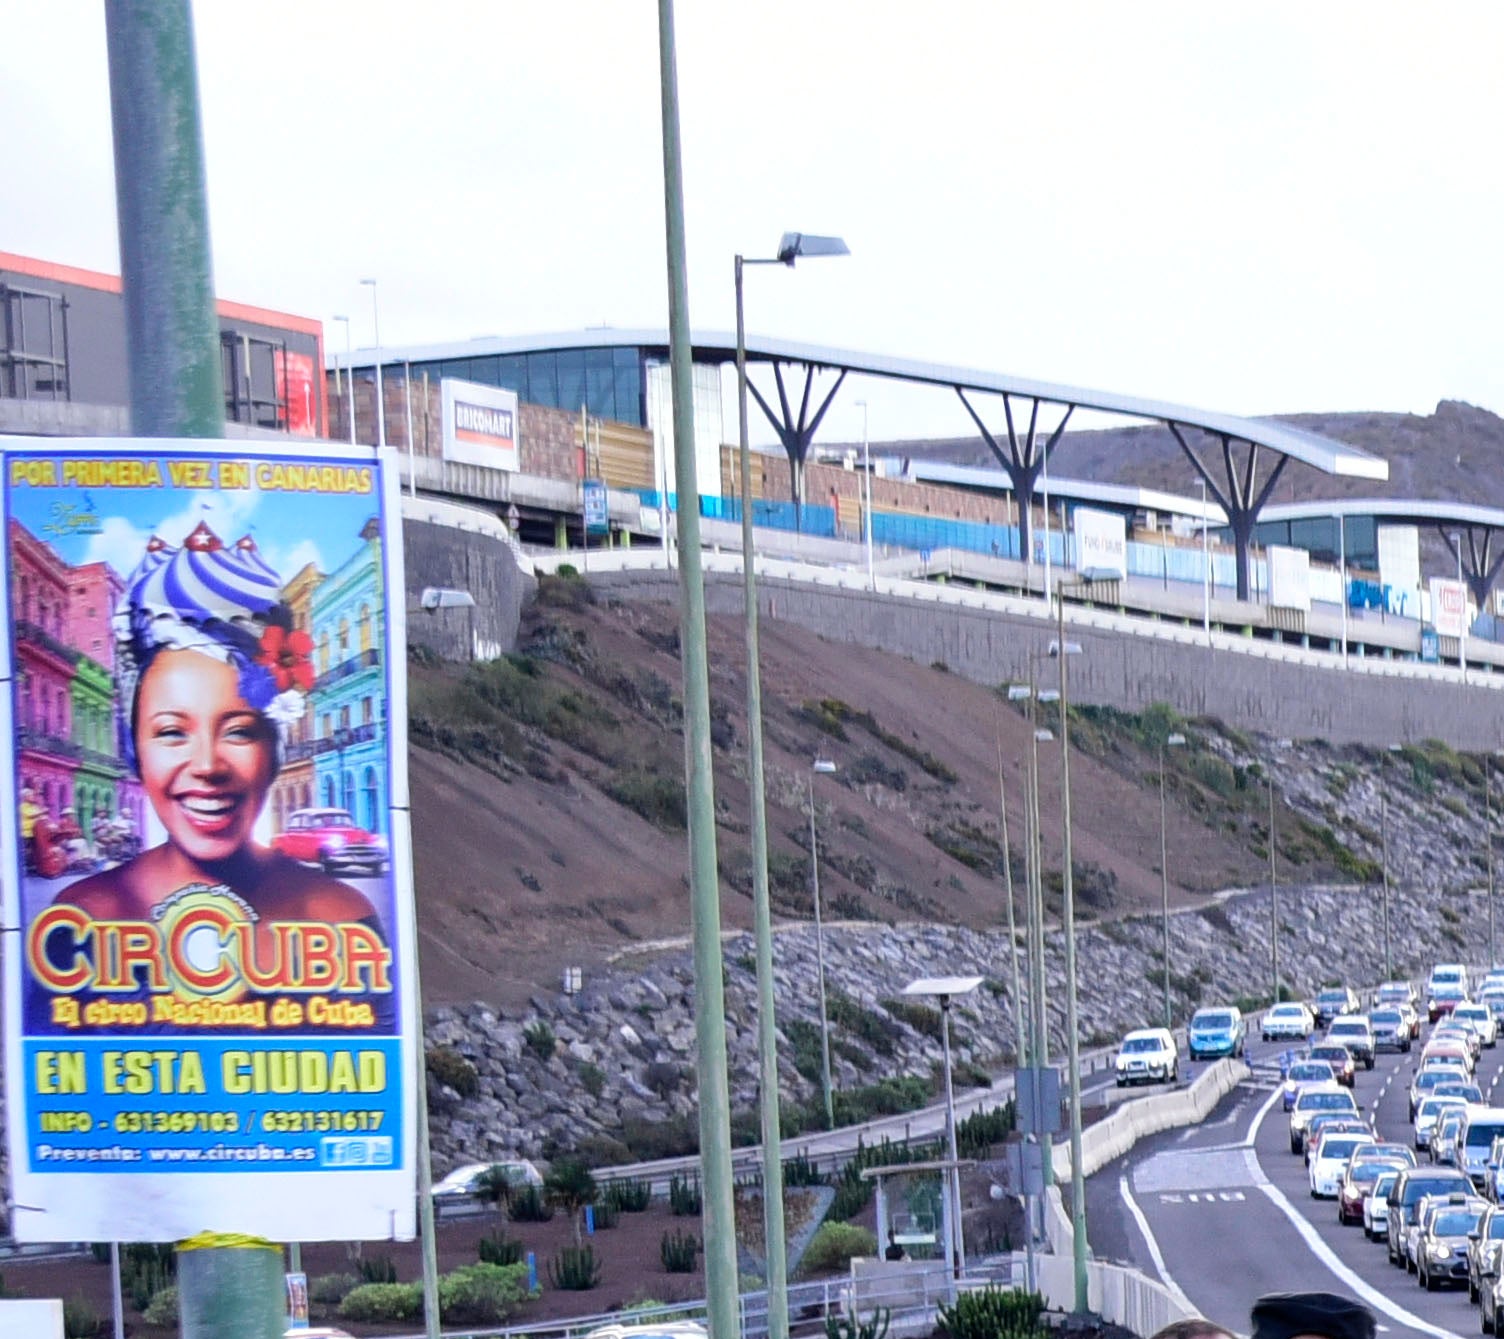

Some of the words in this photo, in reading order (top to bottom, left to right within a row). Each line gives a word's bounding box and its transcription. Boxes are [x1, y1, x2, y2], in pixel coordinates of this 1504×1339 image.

[456, 405, 512, 438] BRICOMART
[11, 461, 57, 487] POR
[62, 461, 163, 488] PRIMERA
[167, 463, 214, 489] VEZ
[219, 464, 251, 489] EN
[256, 465, 373, 493] CANARIAS
[52, 996, 81, 1027] El
[84, 999, 148, 1027] circo
[151, 995, 268, 1028] Nacional
[270, 998, 304, 1025] de
[306, 997, 376, 1027] Cuba
[36, 1050, 87, 1095] EN
[103, 1050, 207, 1095] ESTA
[221, 1050, 387, 1094] CIUDAD
[40, 1111, 93, 1133] INFO
[114, 1111, 240, 1133] 631369103
[261, 1110, 385, 1132] 632131617
[38, 1144, 142, 1163] Preventa:
[149, 1142, 316, 1163] www.circuba.es
